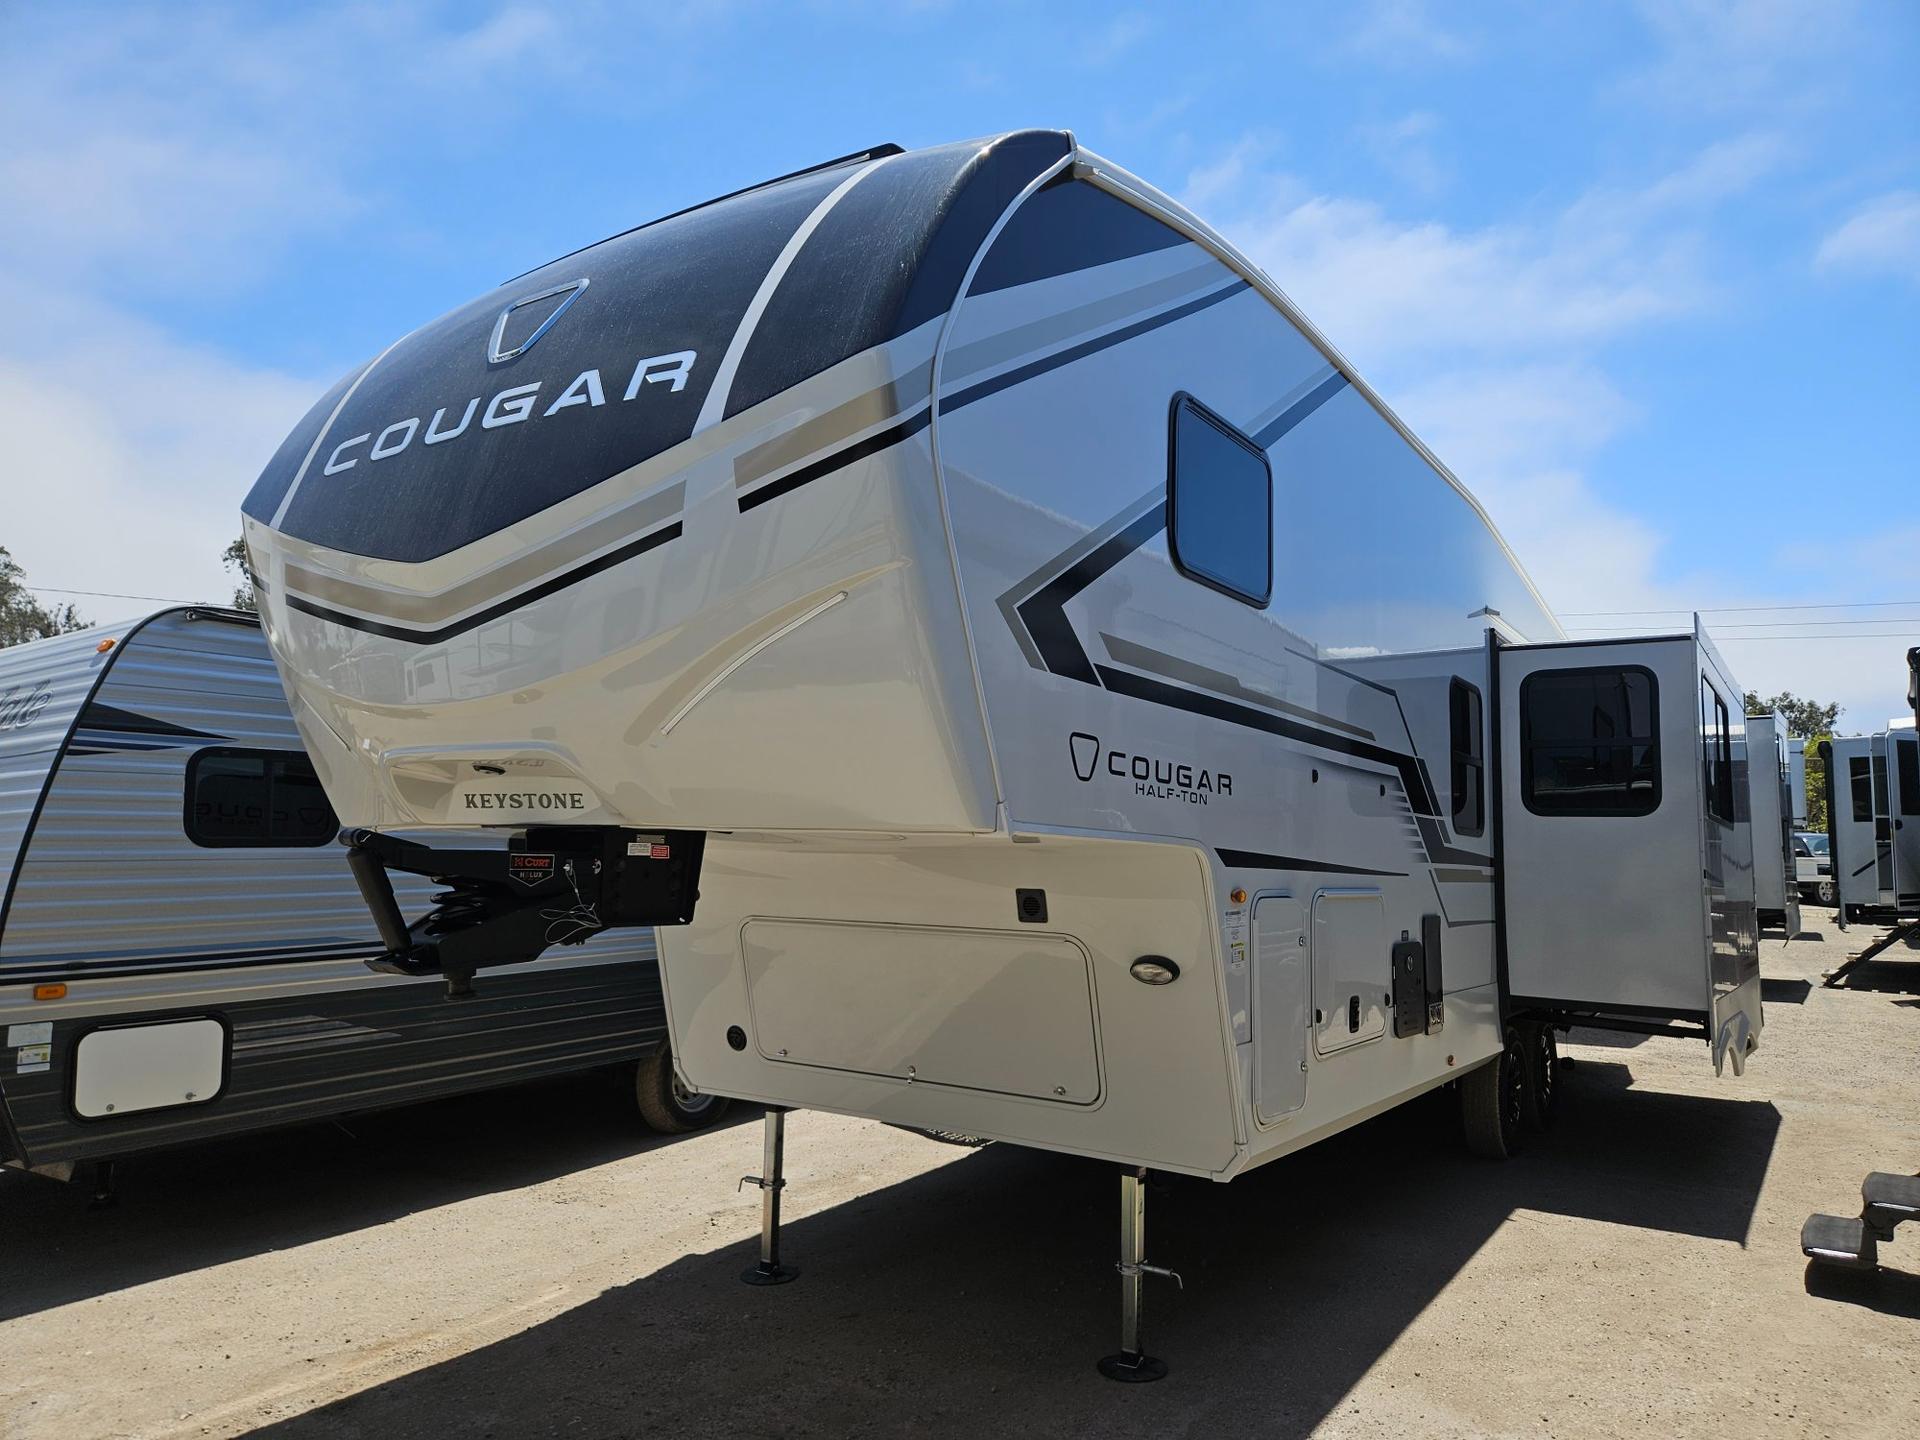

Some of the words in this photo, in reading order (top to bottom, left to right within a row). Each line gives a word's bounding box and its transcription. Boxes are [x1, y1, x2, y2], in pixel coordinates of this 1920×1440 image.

[324, 350, 697, 476] COUGAR
[1108, 751, 1232, 796] COUGAR
[464, 793, 584, 809] KEYSTONE
[1135, 782, 1208, 805] HALF-TON
